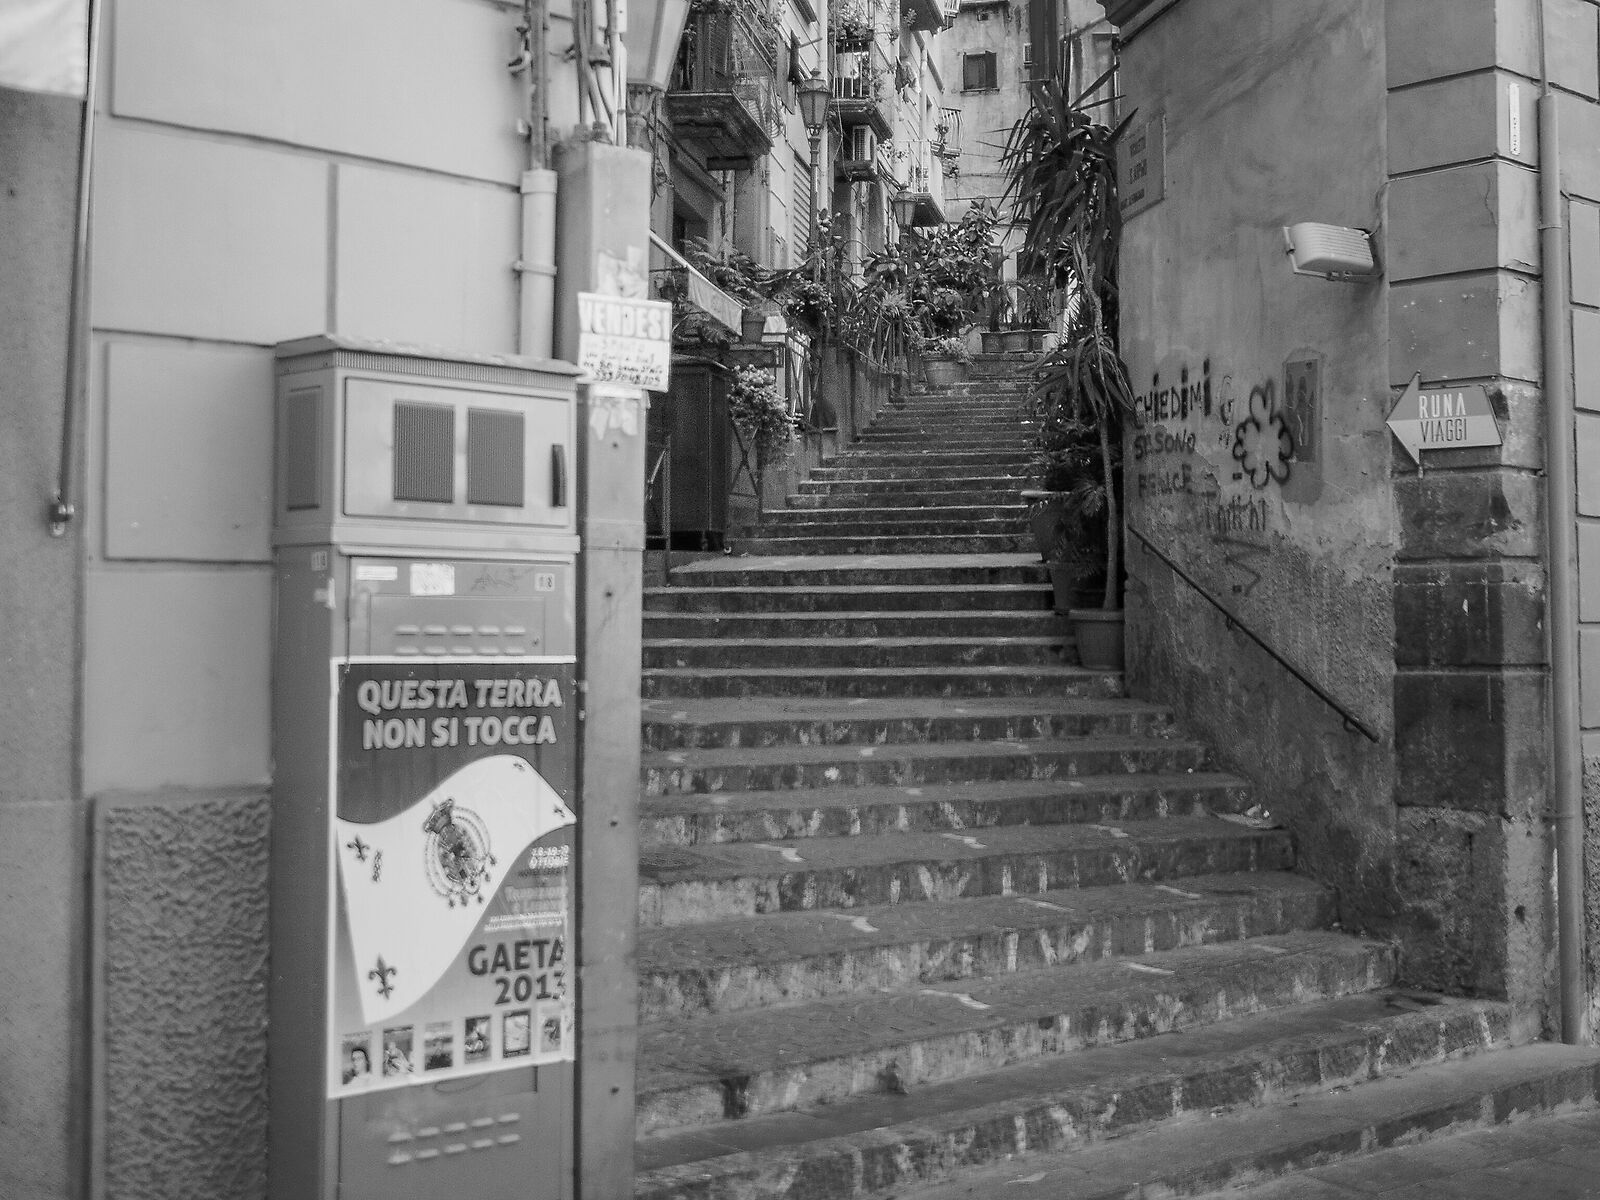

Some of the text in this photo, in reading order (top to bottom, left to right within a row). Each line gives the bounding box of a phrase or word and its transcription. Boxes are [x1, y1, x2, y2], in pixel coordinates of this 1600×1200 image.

[579, 299, 670, 341] VENDESI
[1418, 392, 1466, 419] RUNA
[1420, 418, 1467, 443] VIAGGI
[357, 677, 562, 715] QUESTA TERRA
[362, 714, 557, 750] NON SI TOCCA
[467, 936, 565, 976] GAETA
[495, 970, 566, 1005] 2013
